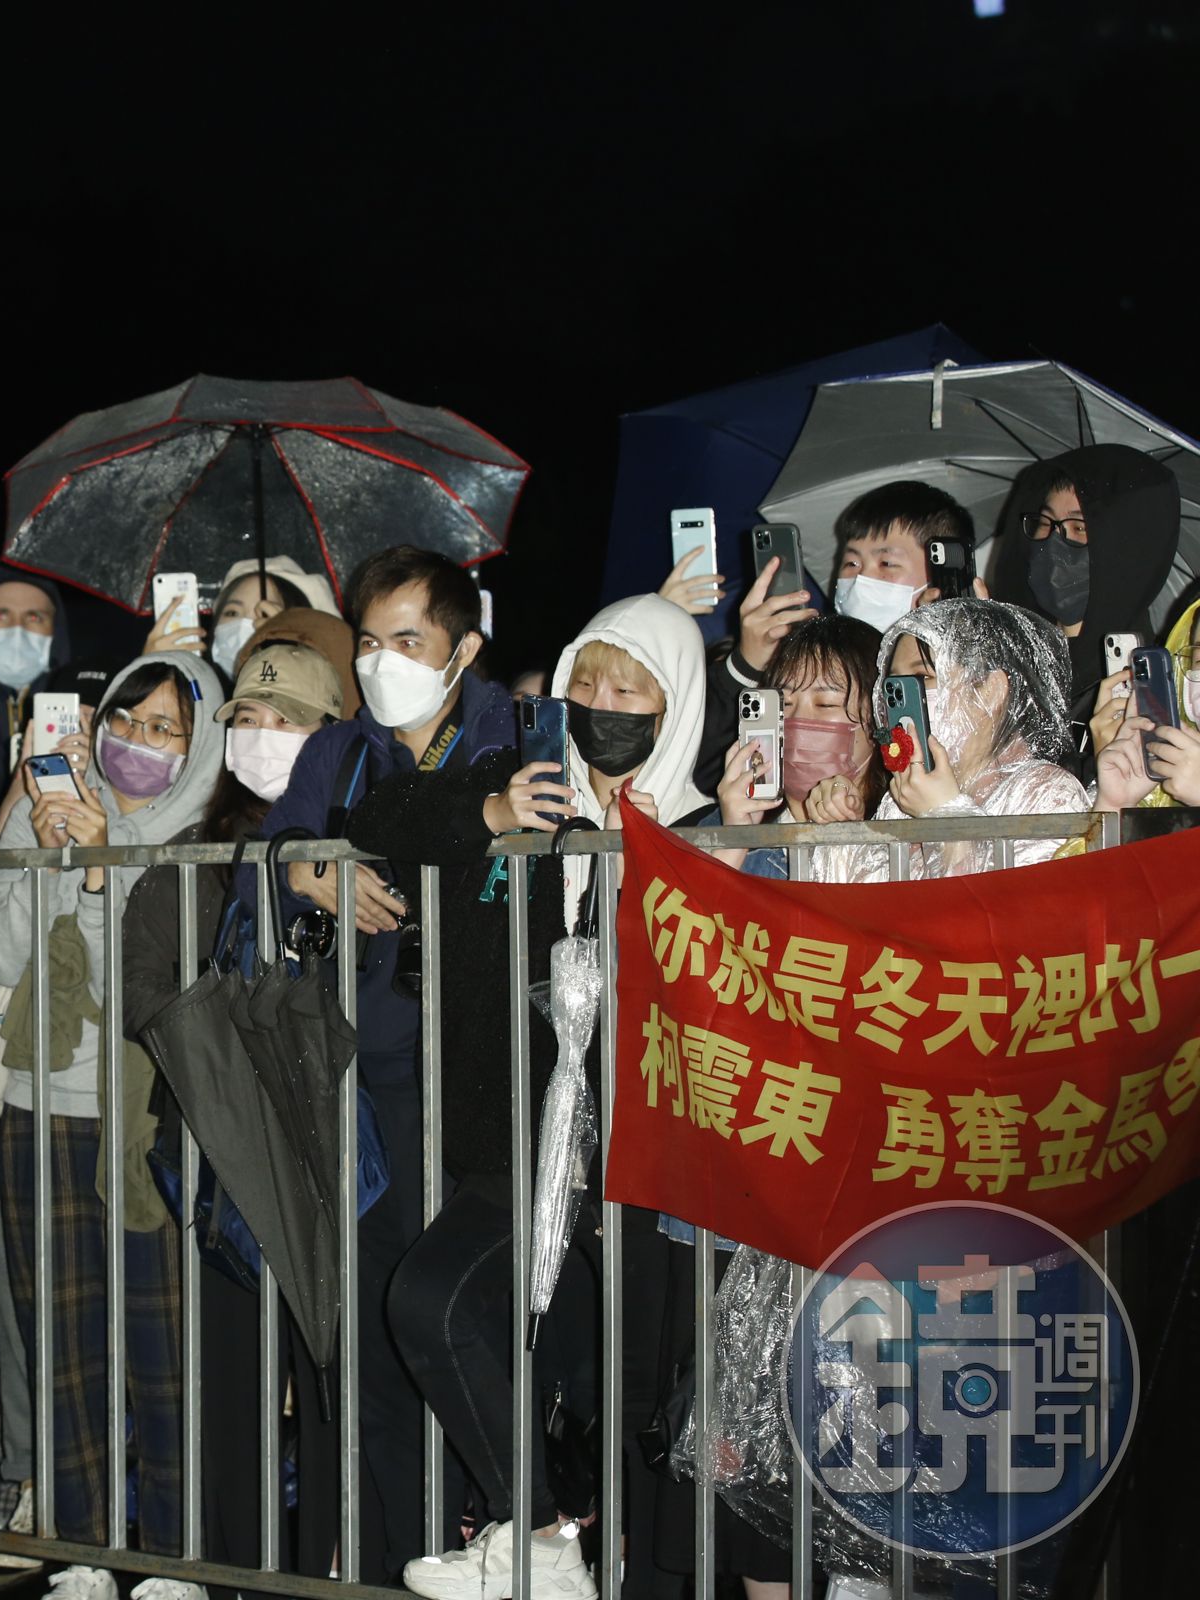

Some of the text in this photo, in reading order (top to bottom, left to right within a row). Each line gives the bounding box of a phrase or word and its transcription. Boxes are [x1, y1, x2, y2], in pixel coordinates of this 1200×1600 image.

[260, 660, 278, 682] LA
[639, 1002, 841, 1165] 柯震東
